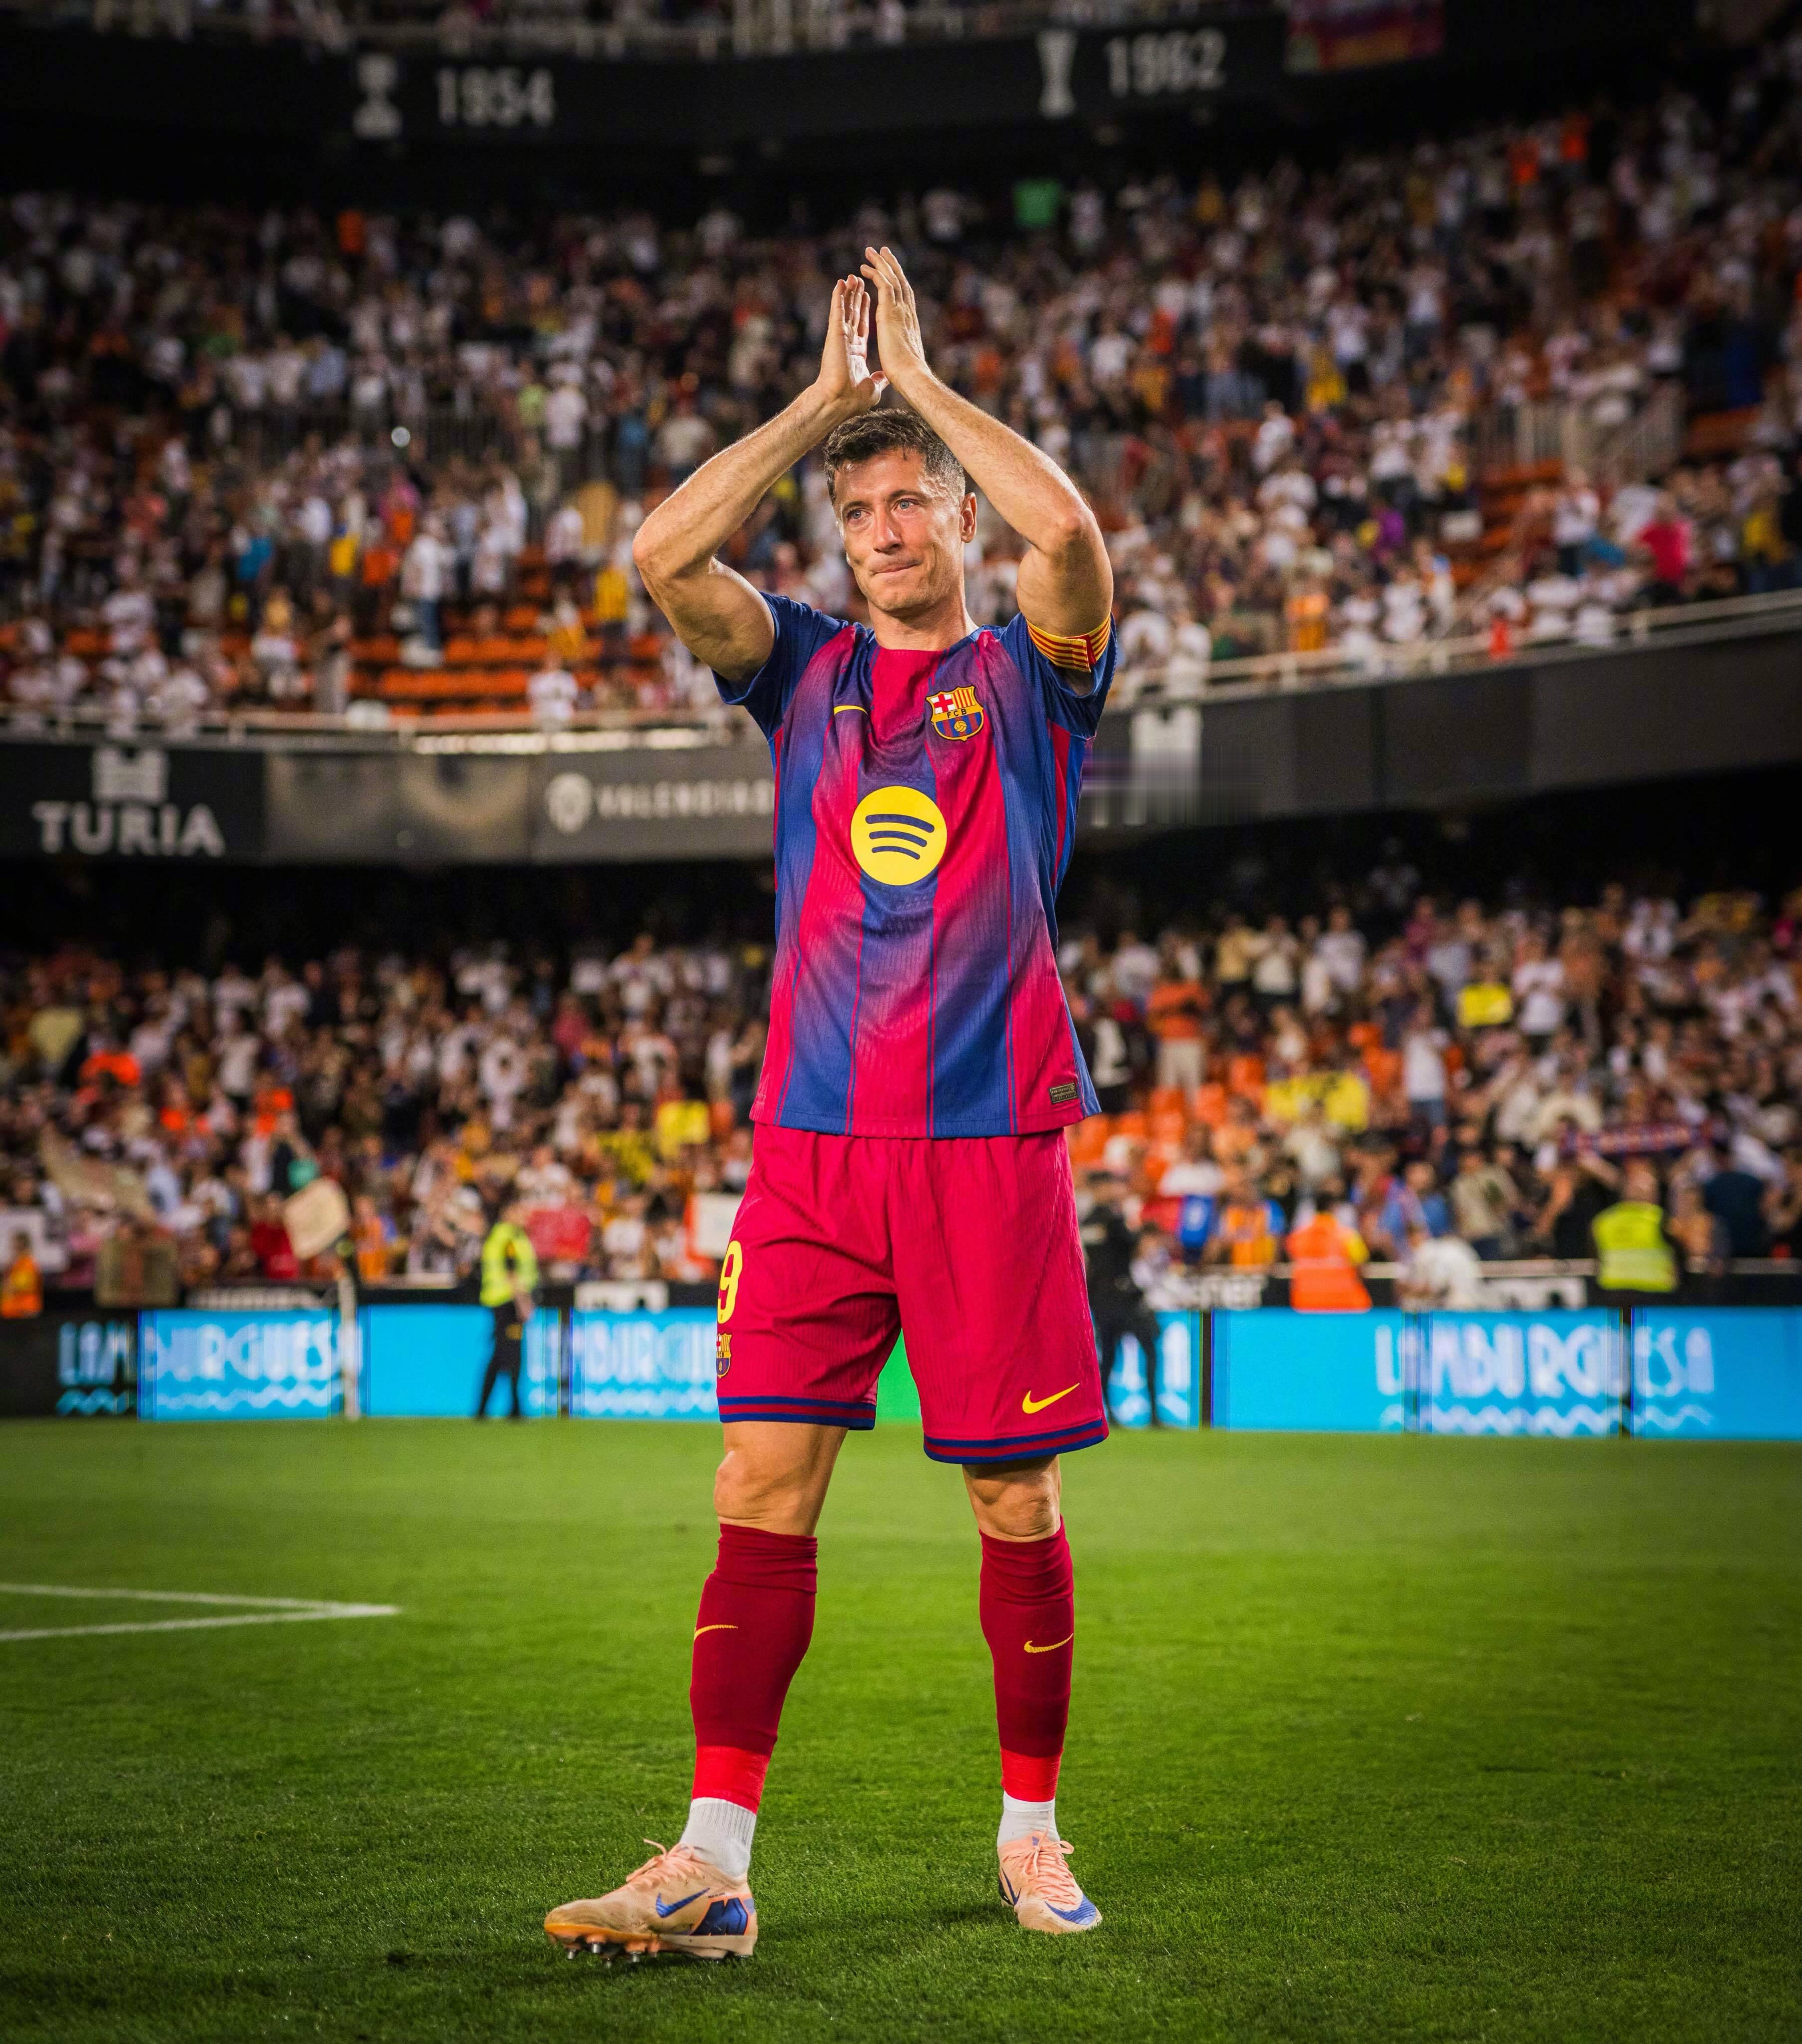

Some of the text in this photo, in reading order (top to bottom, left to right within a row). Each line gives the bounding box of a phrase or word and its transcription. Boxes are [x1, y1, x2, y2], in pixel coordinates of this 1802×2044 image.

[436, 67, 554, 127] 1954
[946, 709, 967, 718] FCB
[32, 800, 225, 857] TURIA
[717, 1240, 743, 1324] 9
